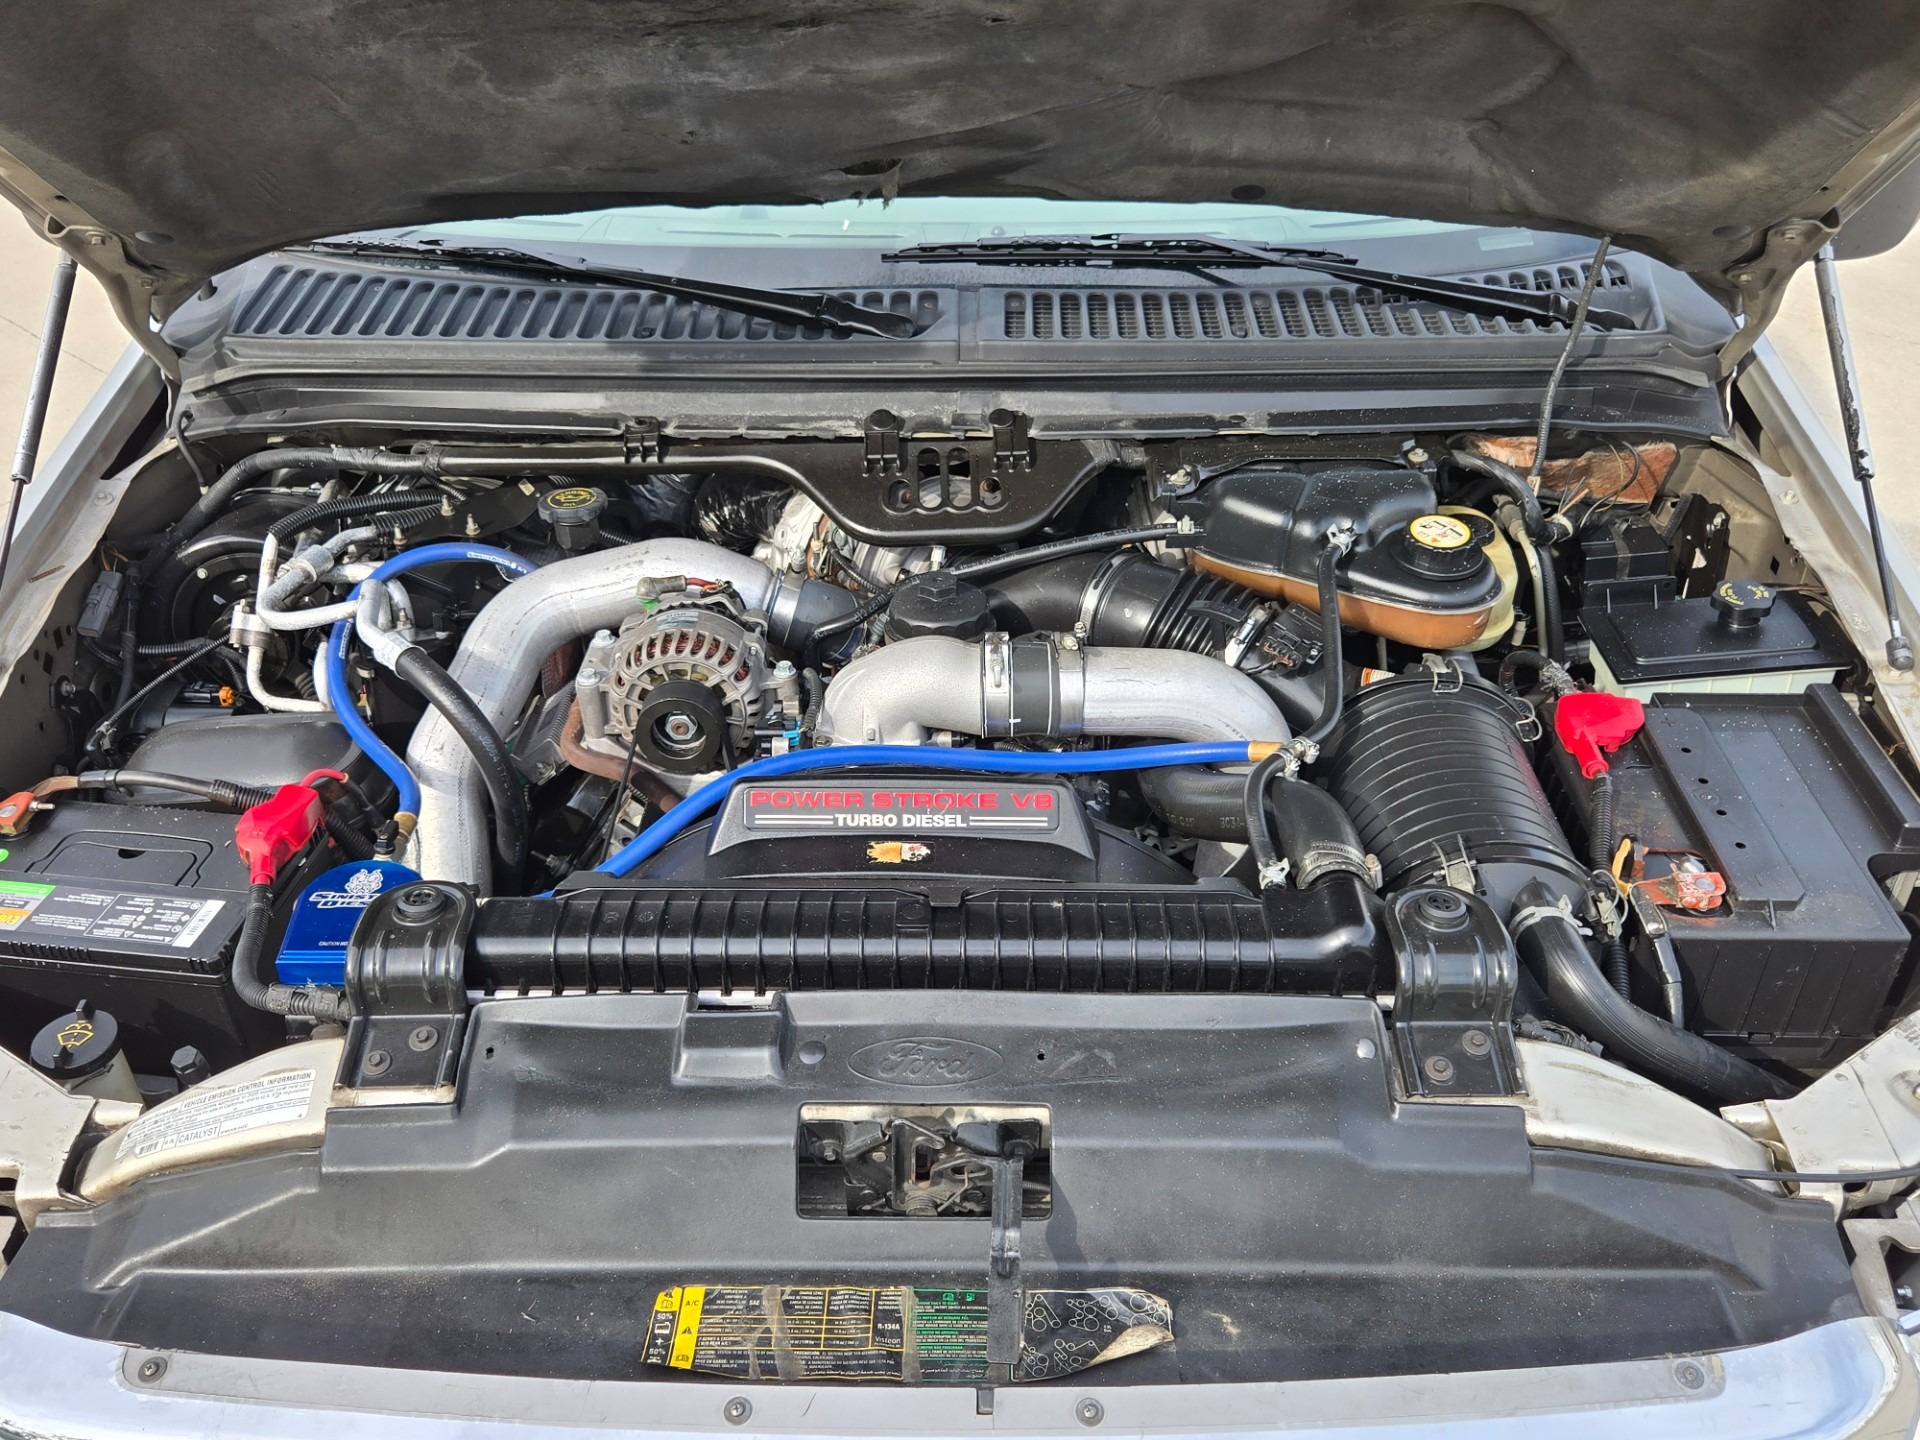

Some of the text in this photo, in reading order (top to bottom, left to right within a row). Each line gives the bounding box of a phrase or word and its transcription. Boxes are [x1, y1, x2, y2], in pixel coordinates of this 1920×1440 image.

[750, 790, 1053, 810] POWER STROKE V8
[835, 813, 967, 828] TURBO DIESEL
[309, 892, 381, 901] SINIST
[877, 1042, 974, 1078] Ford
[184, 1072, 312, 1109] VEHICLE EMISSION CONTROL INFORMATION
[178, 1126, 218, 1143] CATALYST
[875, 1335, 901, 1344] Visteon
